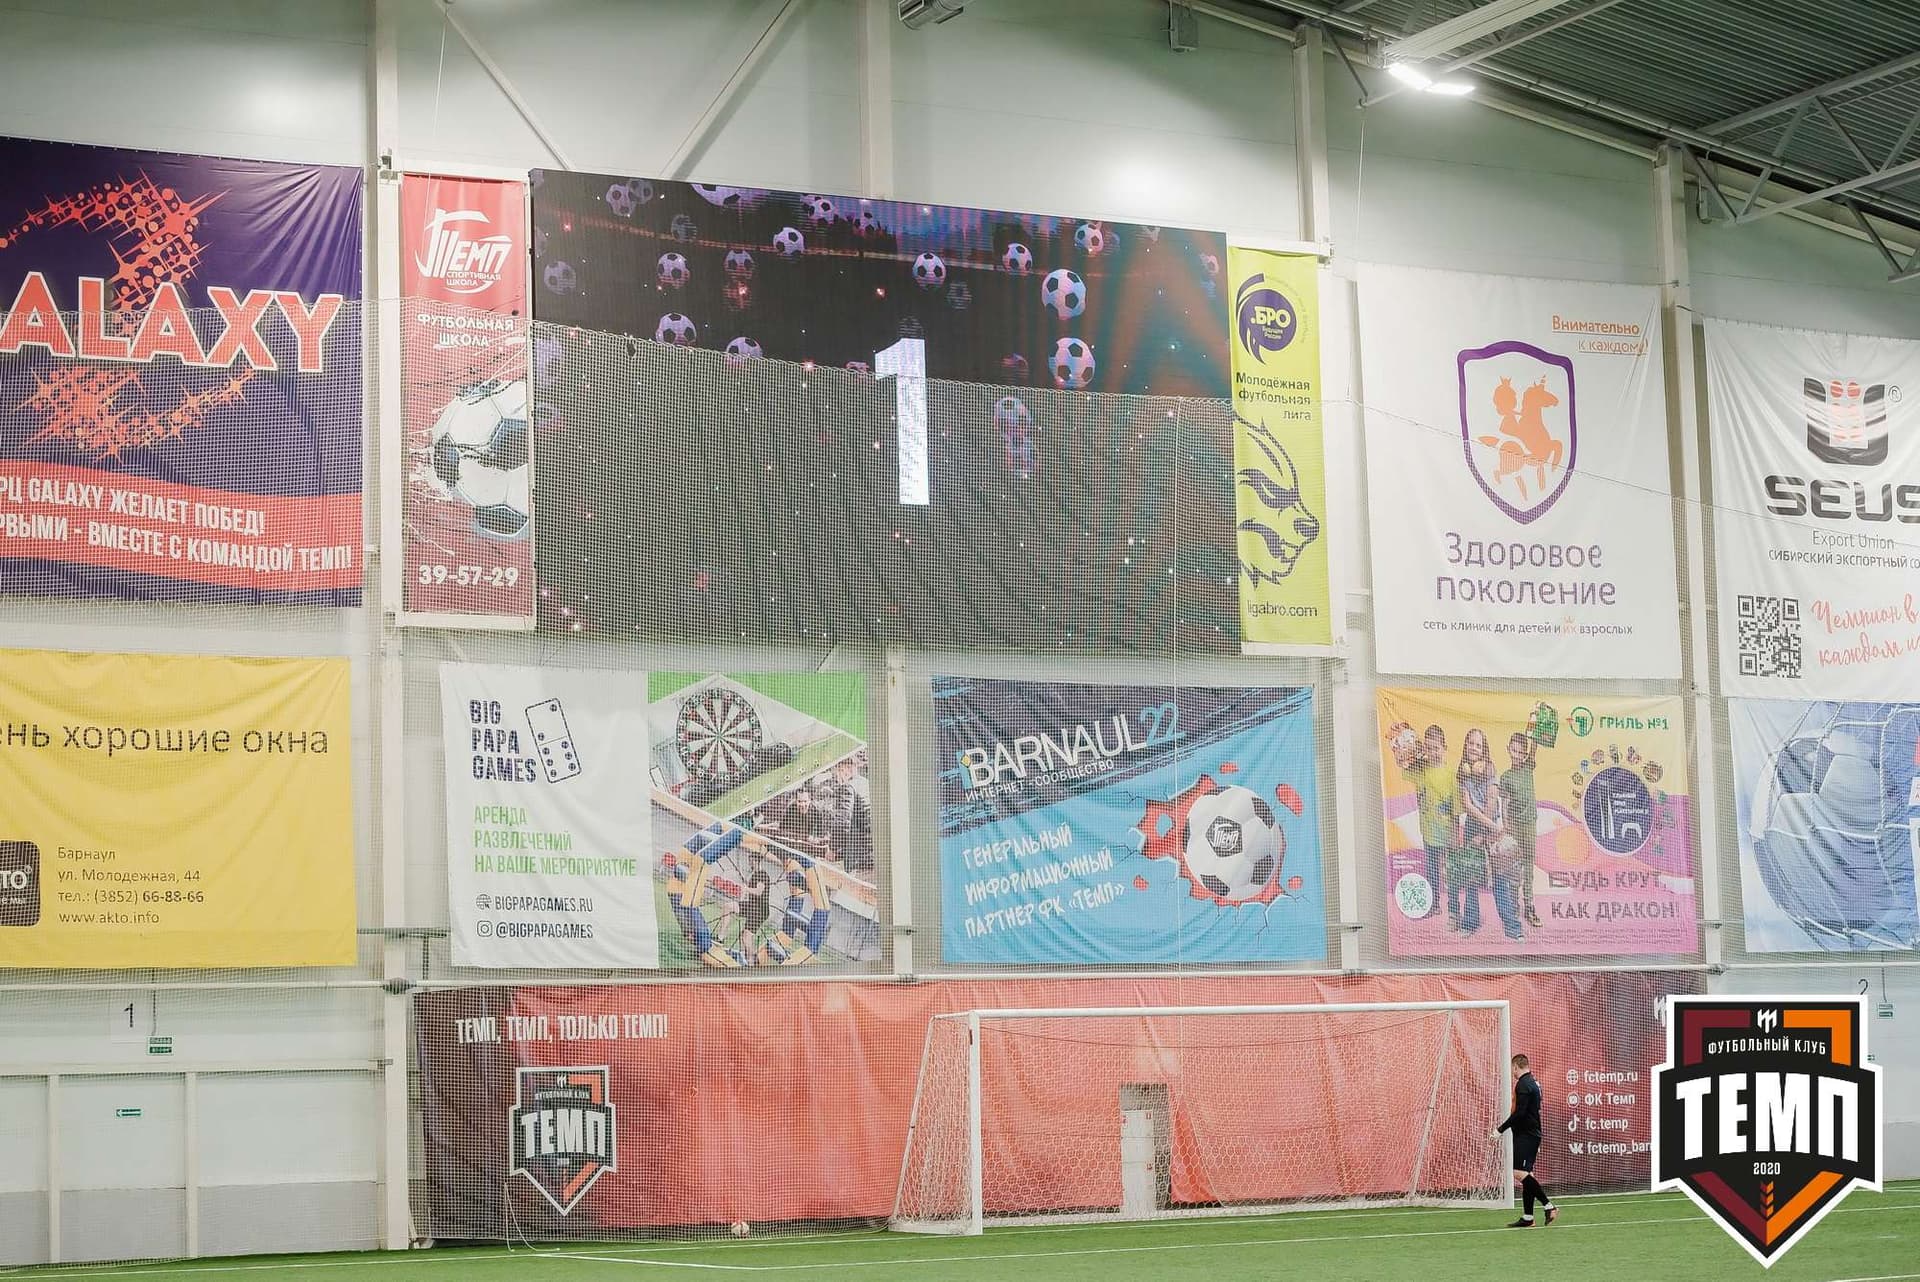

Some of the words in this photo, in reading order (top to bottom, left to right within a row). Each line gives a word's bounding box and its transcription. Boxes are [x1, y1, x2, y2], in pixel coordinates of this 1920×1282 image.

[414, 208, 513, 278] ТЕМП
[446, 271, 502, 281] СПОРТИВНАЯ
[446, 279, 479, 287] ШКОЛА
[417, 313, 514, 331] ФУТБОЛЬНАЯ
[1552, 315, 1640, 335] Внимательно
[439, 333, 490, 347] ШКОЛА
[1589, 340, 1649, 356] каждому
[1236, 372, 1310, 391] Молодёжная
[1238, 387, 1311, 405] футбольная
[875, 338, 929, 505] 1
[1283, 410, 1312, 421] лига
[29, 477, 102, 509] GALAXY
[110, 489, 189, 523] ЖЕЛАЕТ
[194, 503, 265, 537] ПОБЕД!
[1764, 475, 1920, 523] SEUS
[88, 521, 164, 556] ВМЕСТЕ
[169, 535, 182, 559] С
[187, 537, 293, 572] КОМАНДОЙ
[298, 545, 352, 571] ТЕМП!
[1812, 530, 1856, 549] Export
[1859, 536, 1895, 549] Union
[1445, 532, 1602, 570] Здоровое
[1769, 549, 1833, 565] СИБИРСКИЙ
[1836, 555, 1908, 569] ЭКСПОРТНЫЙ
[419, 565, 519, 587] 39-57-29
[1436, 576, 1616, 606] поколение
[1248, 600, 1318, 617] ligabro.com
[1810, 600, 1902, 633] Чемпион
[1904, 592, 1919, 624] в
[1423, 620, 1447, 630] сеть
[1450, 621, 1492, 632] клиник
[1494, 623, 1516, 634] для
[1518, 623, 1551, 634] детей
[1554, 625, 1561, 634] и
[1579, 625, 1633, 637] взрослых
[1819, 632, 1904, 666] каждом
[470, 700, 501, 725] BIG
[1600, 716, 1643, 730] ГРИЛЬ
[1648, 718, 1669, 730] №1
[0, 723, 50, 748] нь
[62, 726, 231, 757] хорошие
[243, 729, 328, 753] окна
[471, 728, 520, 755] PAPA
[472, 755, 536, 783] GAMES
[965, 779, 1025, 802] ИНТЕРНЕТ
[1035, 759, 1115, 787] СООБЩЕСТВО
[474, 805, 526, 827] АРЕНДА
[474, 830, 572, 851] РАЗВЛЕЧЕНИЙ
[962, 822, 1073, 870] ГЕНЕРАЛЬНЫЙ
[58, 847, 116, 862] Барнаул
[58, 869, 78, 882] ул.
[82, 869, 180, 883] Молодежная,
[183, 870, 201, 881] 44
[474, 855, 494, 873] НА
[497, 856, 537, 874] ВАШЕ
[540, 857, 637, 876] МЕРОПРИЯТИЕ
[965, 846, 1114, 906] ИНФОРМАЦИОННЫЙ
[1549, 871, 1609, 892] БУДЬ
[1615, 871, 1668, 892] КРУТ,
[58, 892, 90, 902] тел.:
[94, 889, 138, 904] (3852)
[142, 890, 204, 903] 66-88-66
[495, 896, 593, 912] BIGPAPAGAMES.RU
[59, 912, 160, 924] www.akto.info
[965, 903, 1034, 939] ПАРТНЕР
[1038, 895, 1065, 920] ФК
[1068, 883, 1127, 911] «ТЕМП»
[1551, 901, 1591, 918] КАК
[1595, 902, 1681, 922] ДРАКОН!
[496, 921, 593, 939] @BIGPAPAGAMES
[124, 1003, 133, 1028] 1
[456, 1017, 501, 1044] ТЕМП,
[506, 1016, 553, 1043] ТЕМП,
[558, 1015, 618, 1040] ТОЛЬКО
[624, 1014, 668, 1039] ТЕМП!
[1584, 1070, 1638, 1085] fctemp.ru
[1584, 1093, 1603, 1106] ФК
[1606, 1093, 1635, 1104] Темп
[521, 1108, 606, 1158] ТЕМП
[1585, 1117, 1629, 1132] fc.temp
